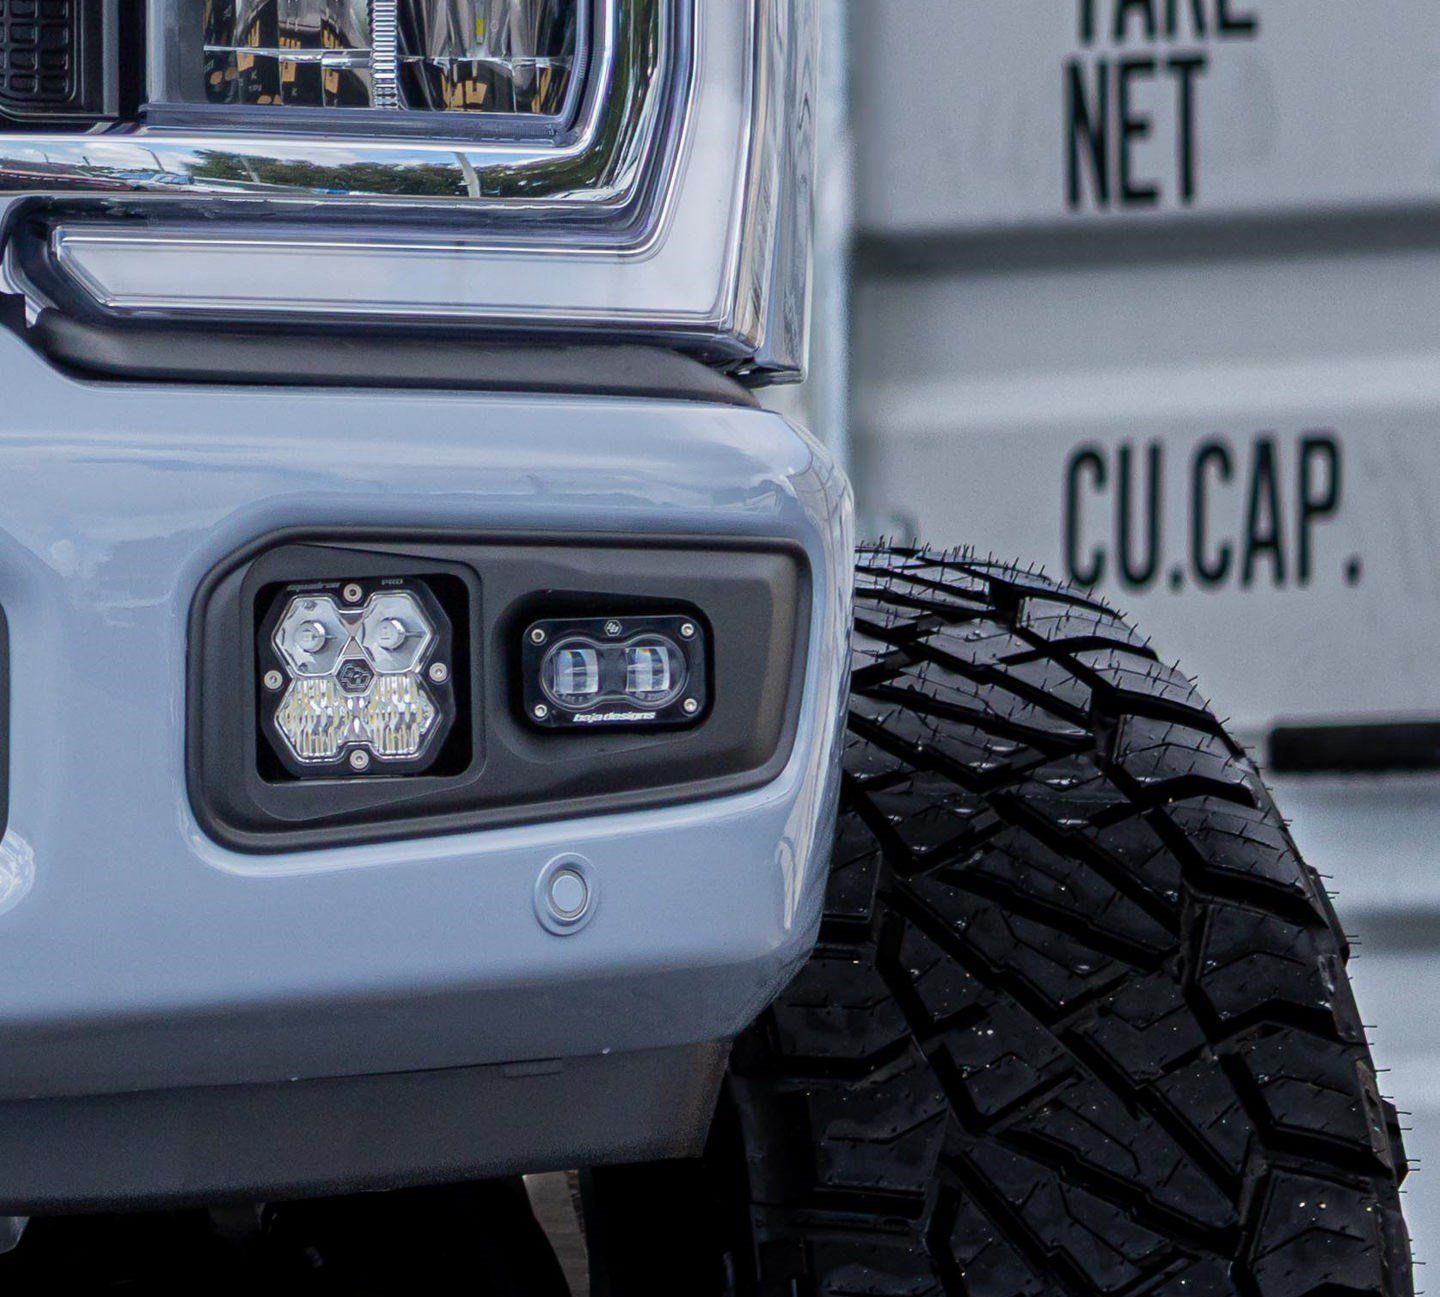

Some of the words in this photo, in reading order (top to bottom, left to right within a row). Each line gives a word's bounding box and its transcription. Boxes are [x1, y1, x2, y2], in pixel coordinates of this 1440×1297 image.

[1063, 53, 1208, 211] NET
[572, 712, 603, 724] baja
[603, 711, 656, 722] designs
